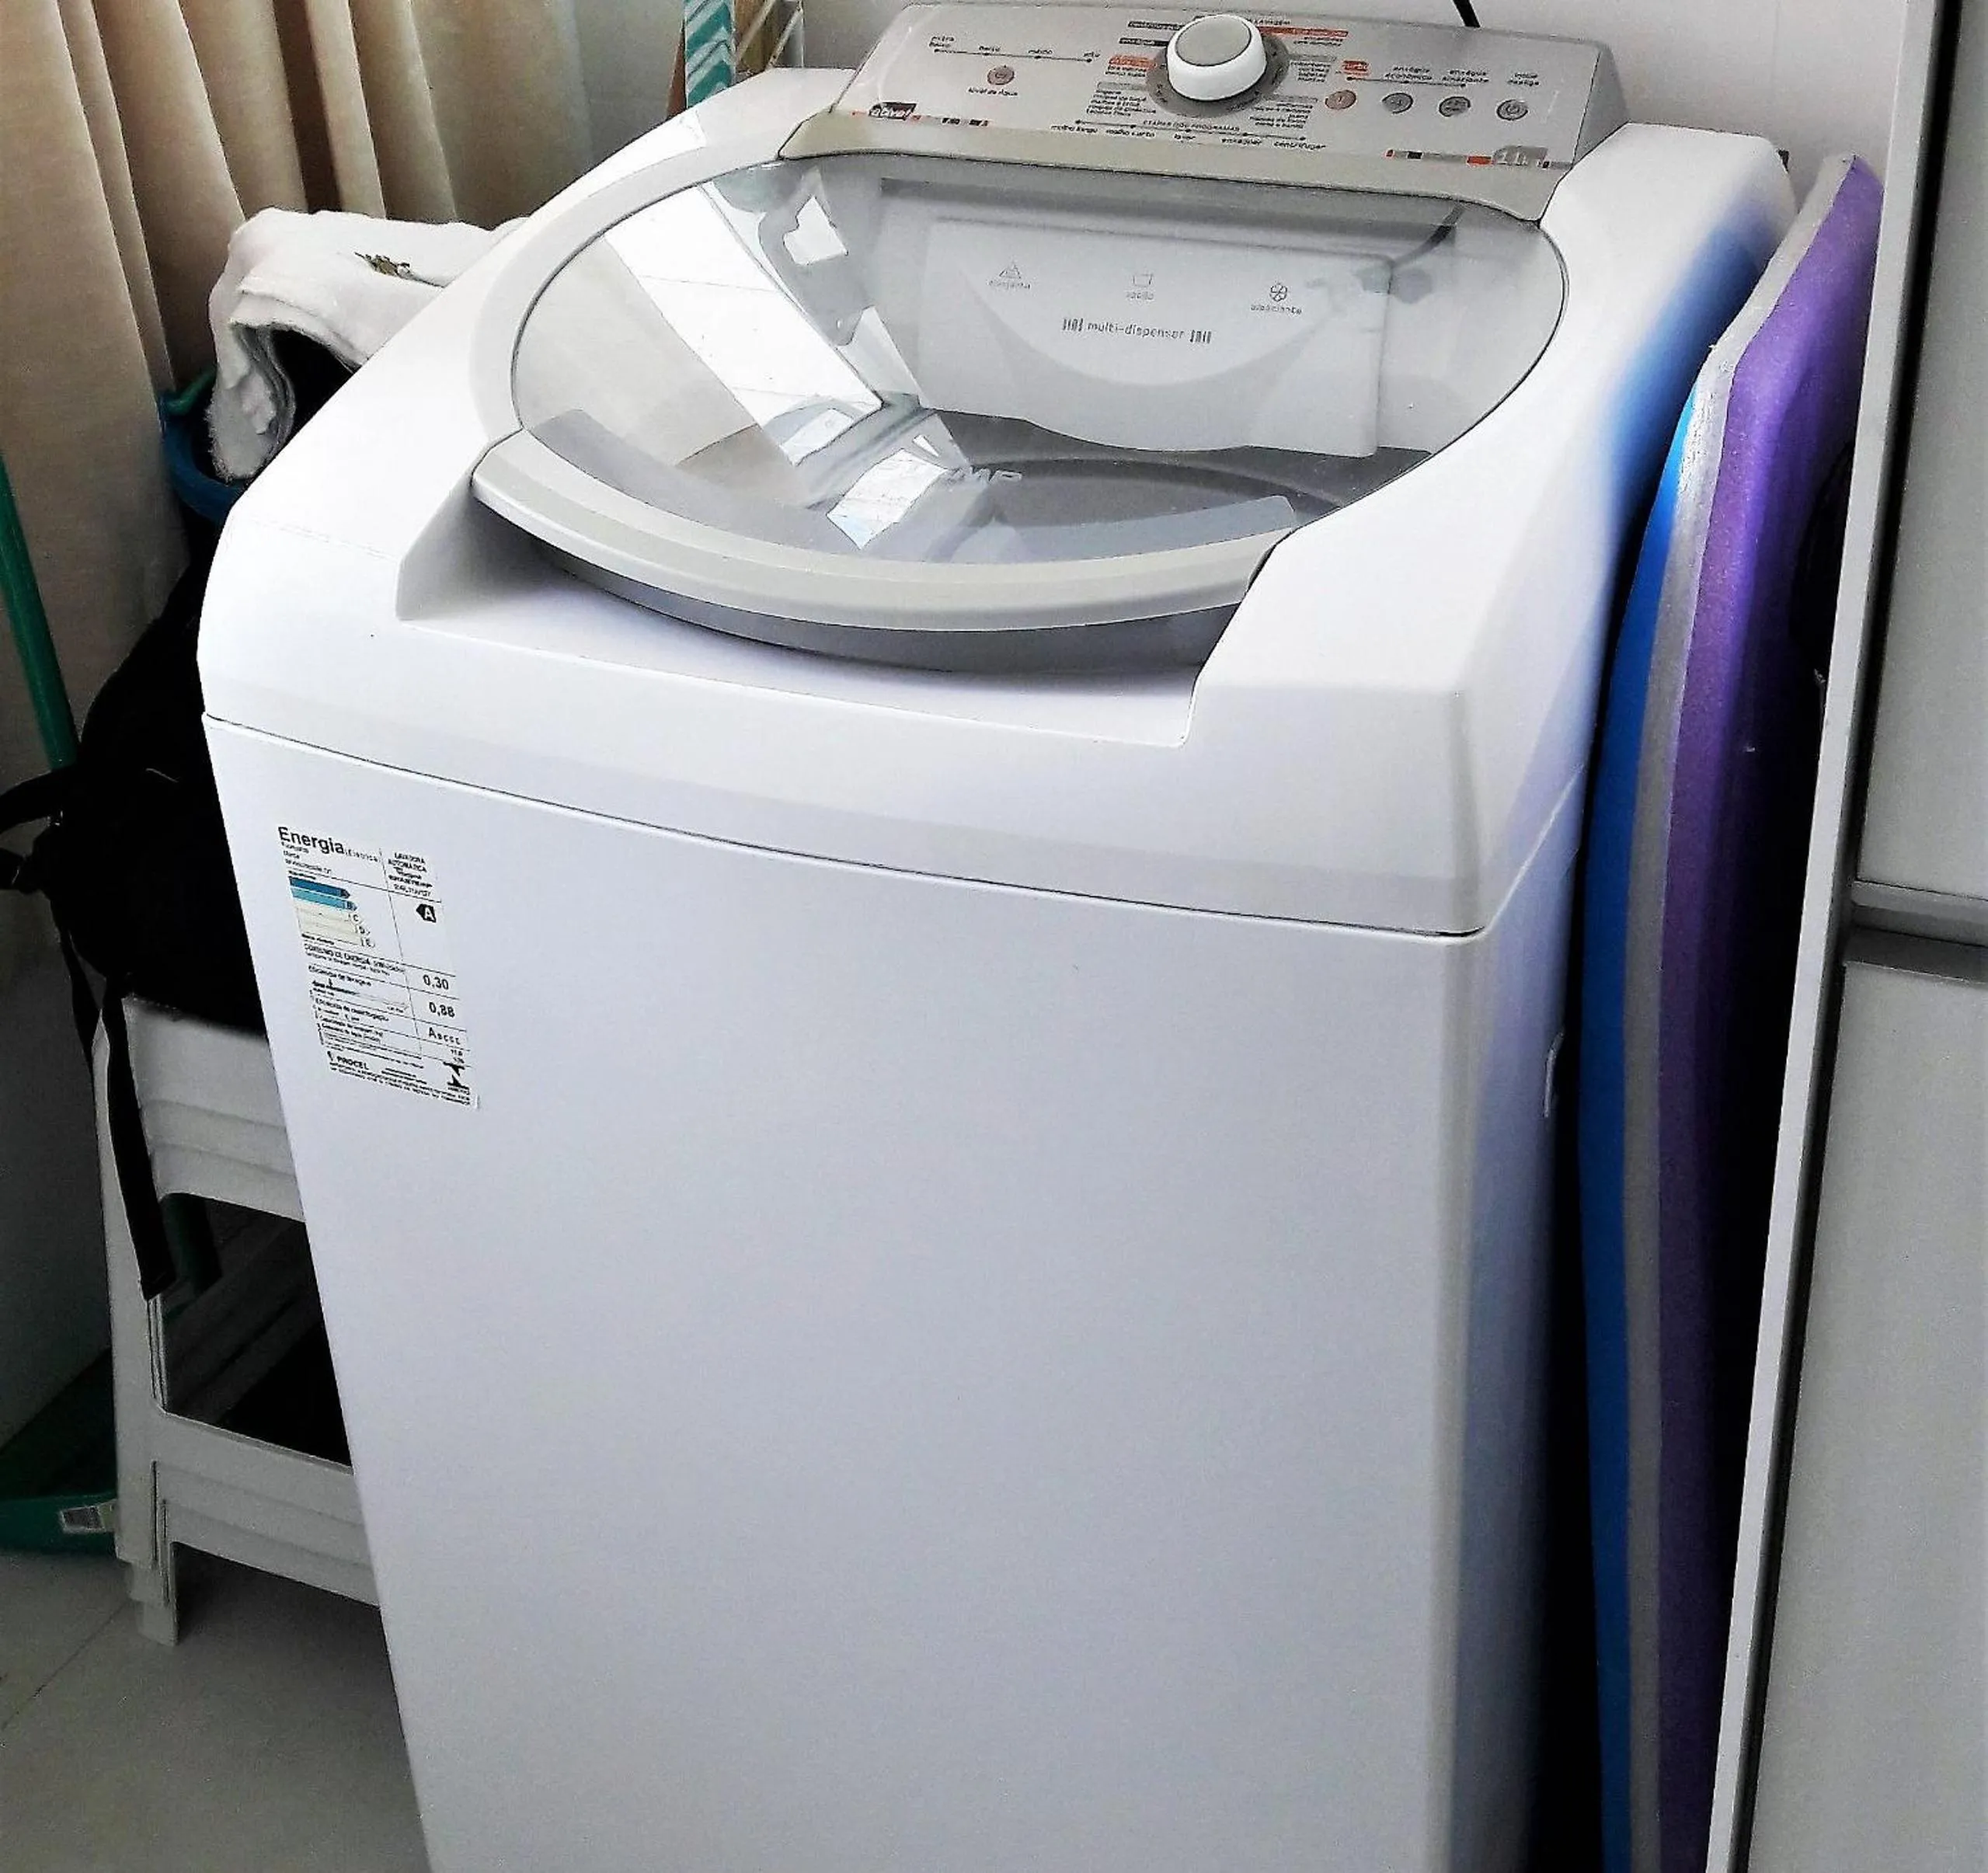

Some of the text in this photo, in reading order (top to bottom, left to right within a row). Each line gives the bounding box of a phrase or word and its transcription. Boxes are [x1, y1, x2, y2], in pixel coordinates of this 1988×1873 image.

[1087, 322, 1185, 342] multi-dispenser
[277, 826, 345, 855] Energia
[336, 1055, 370, 1071] PROCEL
